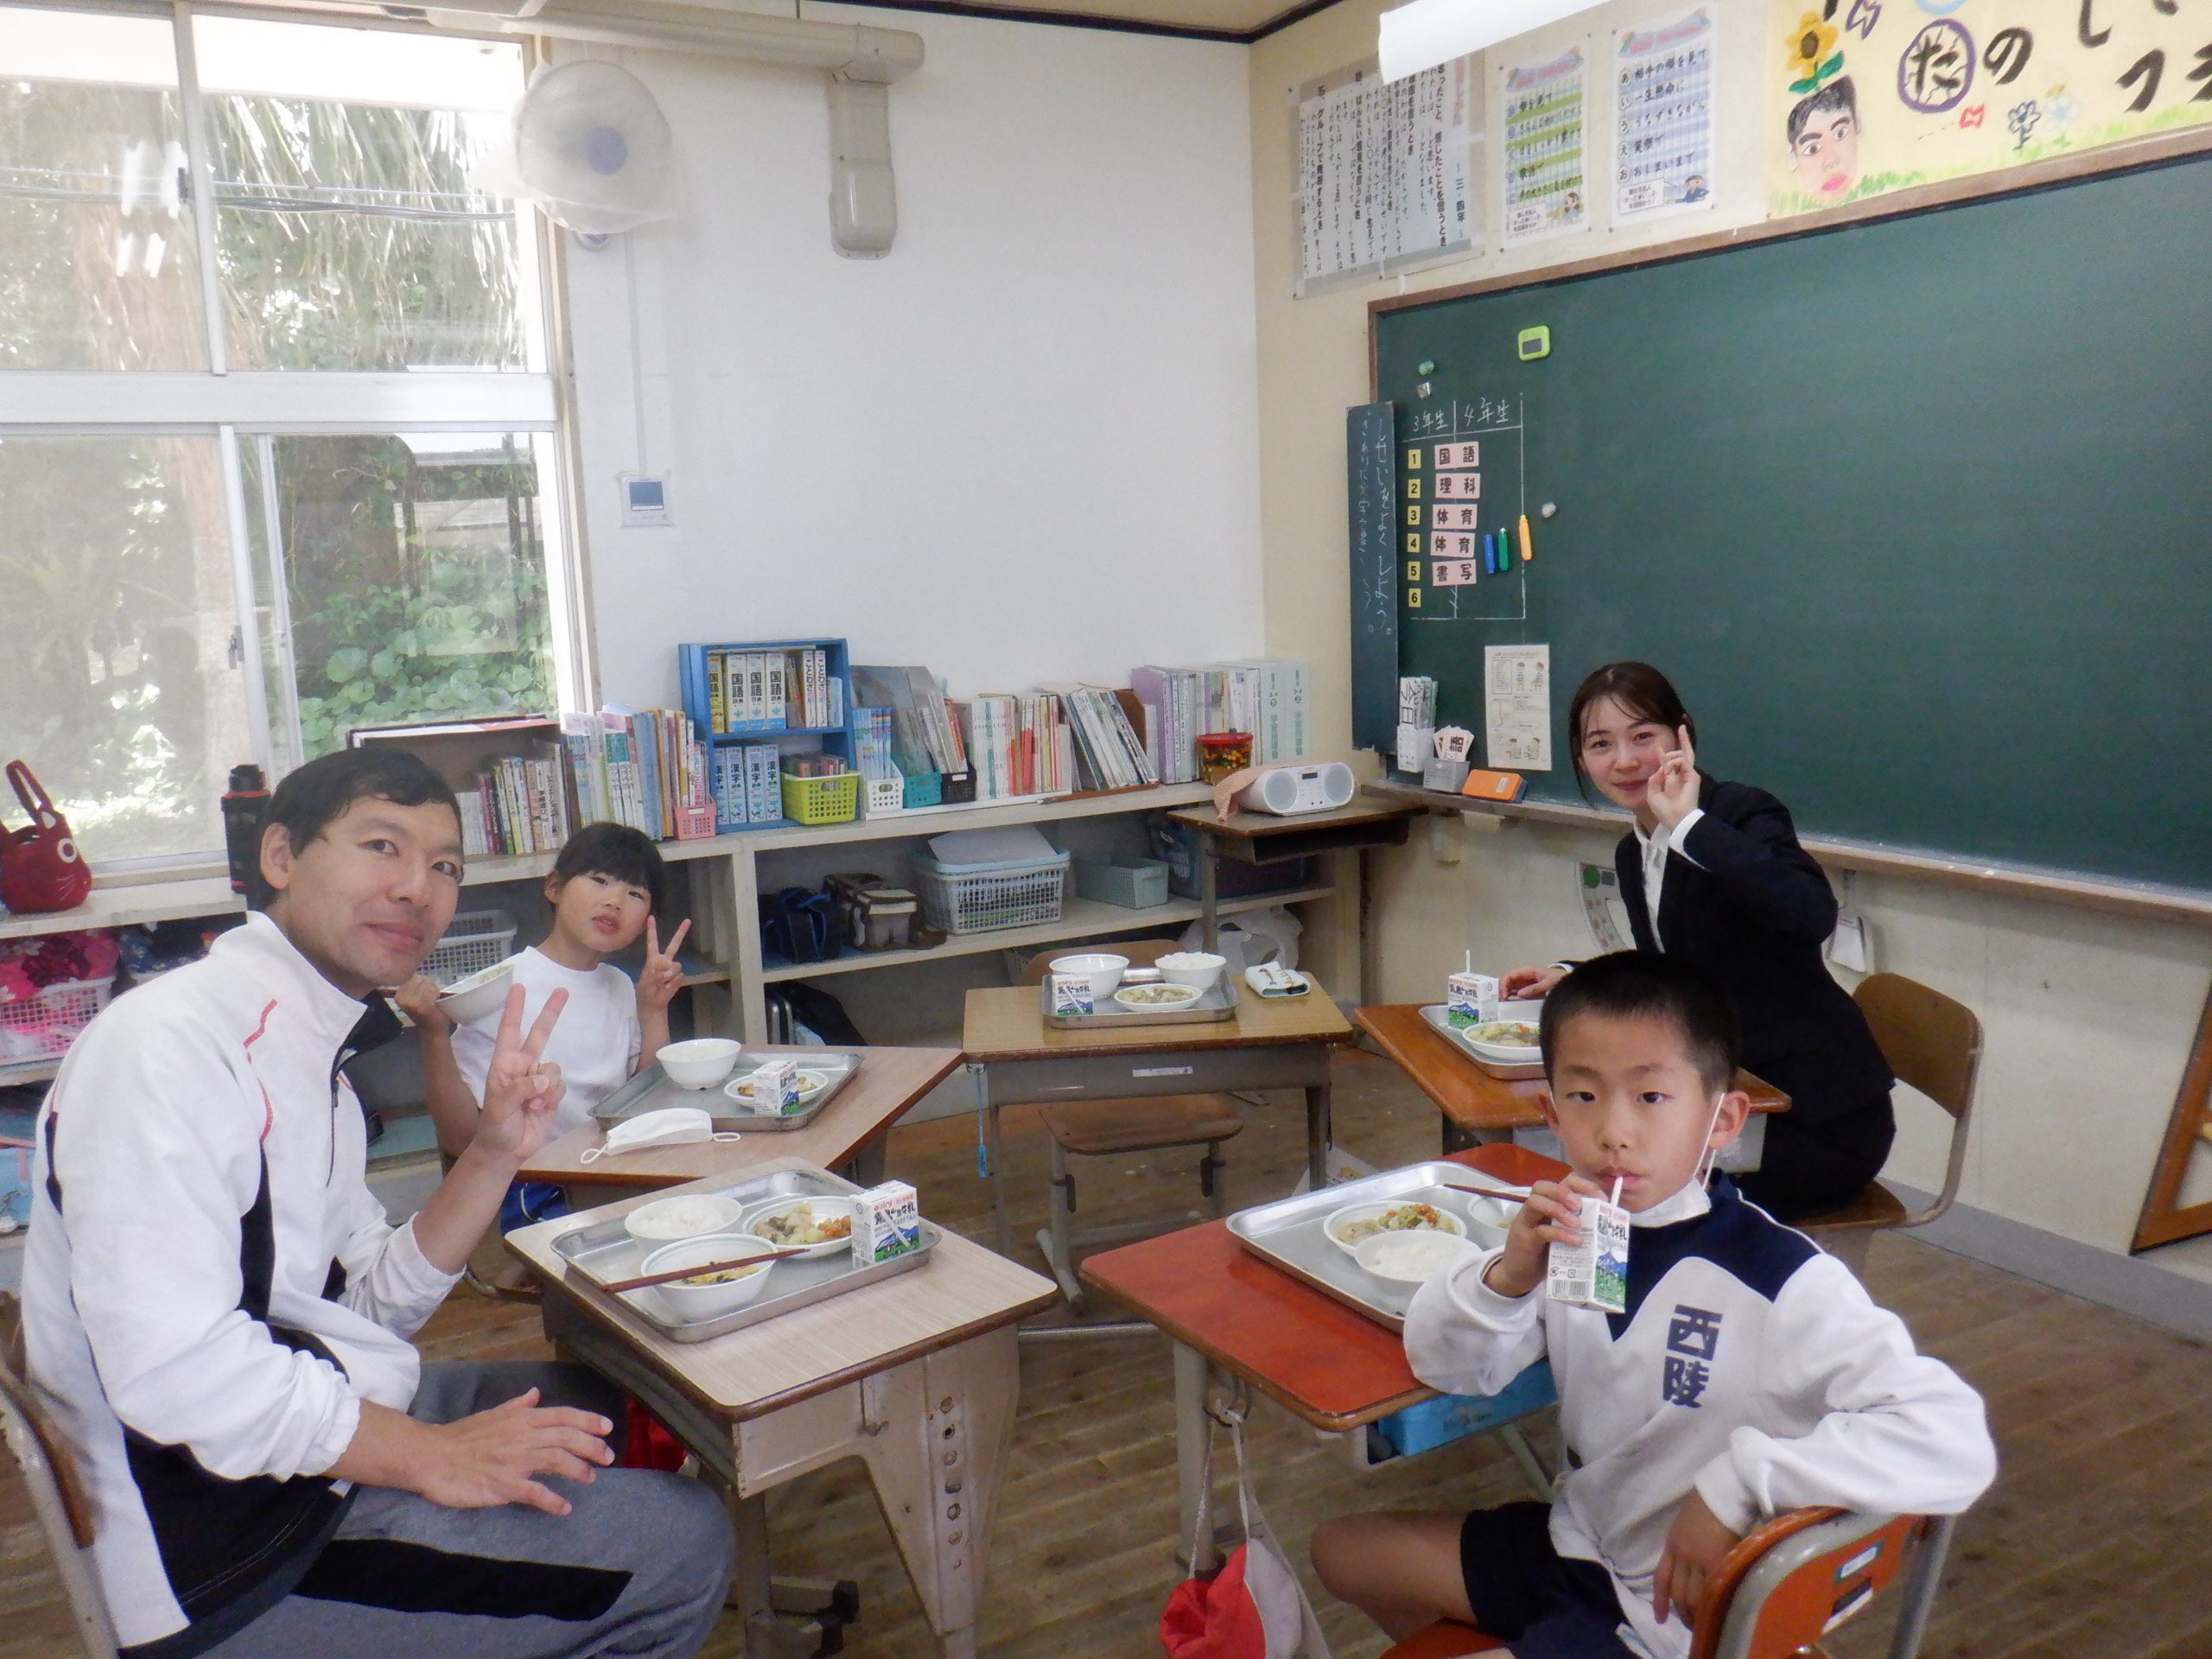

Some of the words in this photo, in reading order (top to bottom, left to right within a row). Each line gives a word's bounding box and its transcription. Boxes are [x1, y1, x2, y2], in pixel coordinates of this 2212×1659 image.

[1635, 48, 1708, 79] 相手の顔を見て
[1635, 79, 1684, 102] 一生懸命に
[1636, 101, 1705, 126] うなずきながら
[1635, 132, 1664, 153] 笑顔で
[1634, 151, 1694, 176] おしまいまで
[1413, 410, 1450, 435] 3年生
[1465, 397, 1510, 427] 4年生
[1410, 454, 1417, 465] 1
[1439, 445, 1476, 465] 国語
[1410, 483, 1418, 494] 2
[1440, 477, 1477, 496] 理科
[1410, 510, 1418, 521] 3
[1436, 507, 1473, 526] 体育
[1409, 538, 1418, 550] 4
[1434, 535, 1471, 553] 体育
[1410, 565, 1418, 576] 5
[1436, 563, 1472, 582] 書写
[1411, 593, 1418, 604] 6
[1663, 1304, 1723, 1408] 西陵
